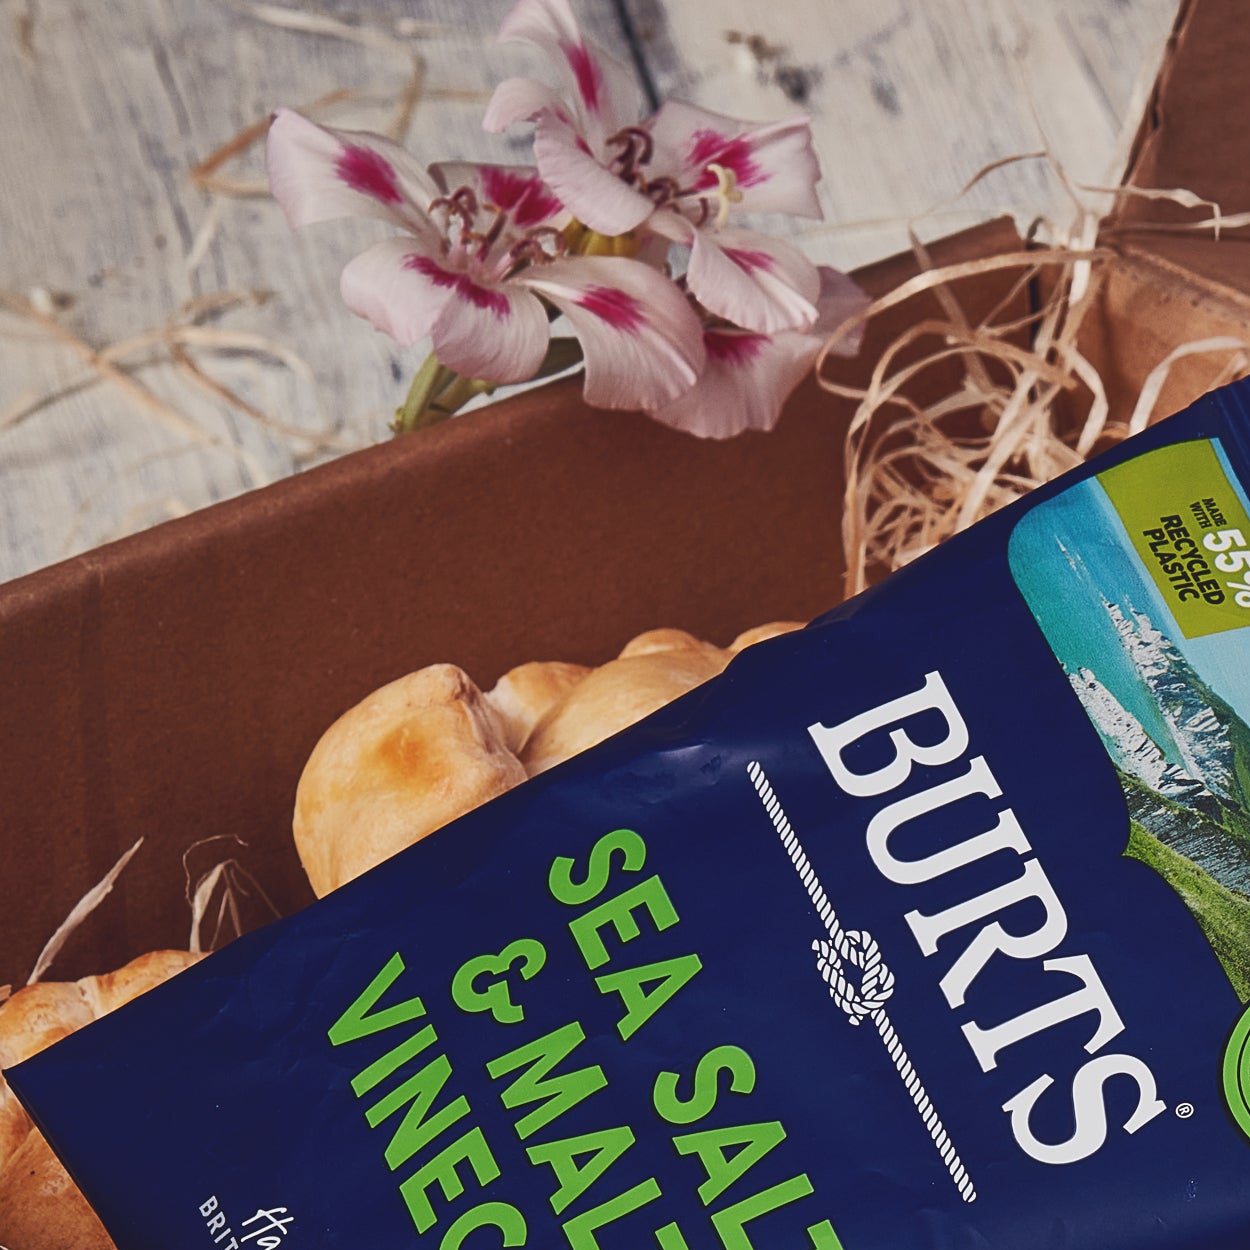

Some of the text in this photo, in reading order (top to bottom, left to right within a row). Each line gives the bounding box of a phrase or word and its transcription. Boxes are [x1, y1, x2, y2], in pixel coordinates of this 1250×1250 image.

[1190, 502, 1212, 528] WITH
[1202, 498, 1227, 526] MADE
[1143, 528, 1199, 602] PLASTIC
[1160, 515, 1225, 604] RECYCLED
[548, 828, 702, 1041] SEA
[451, 938, 547, 1023] &
